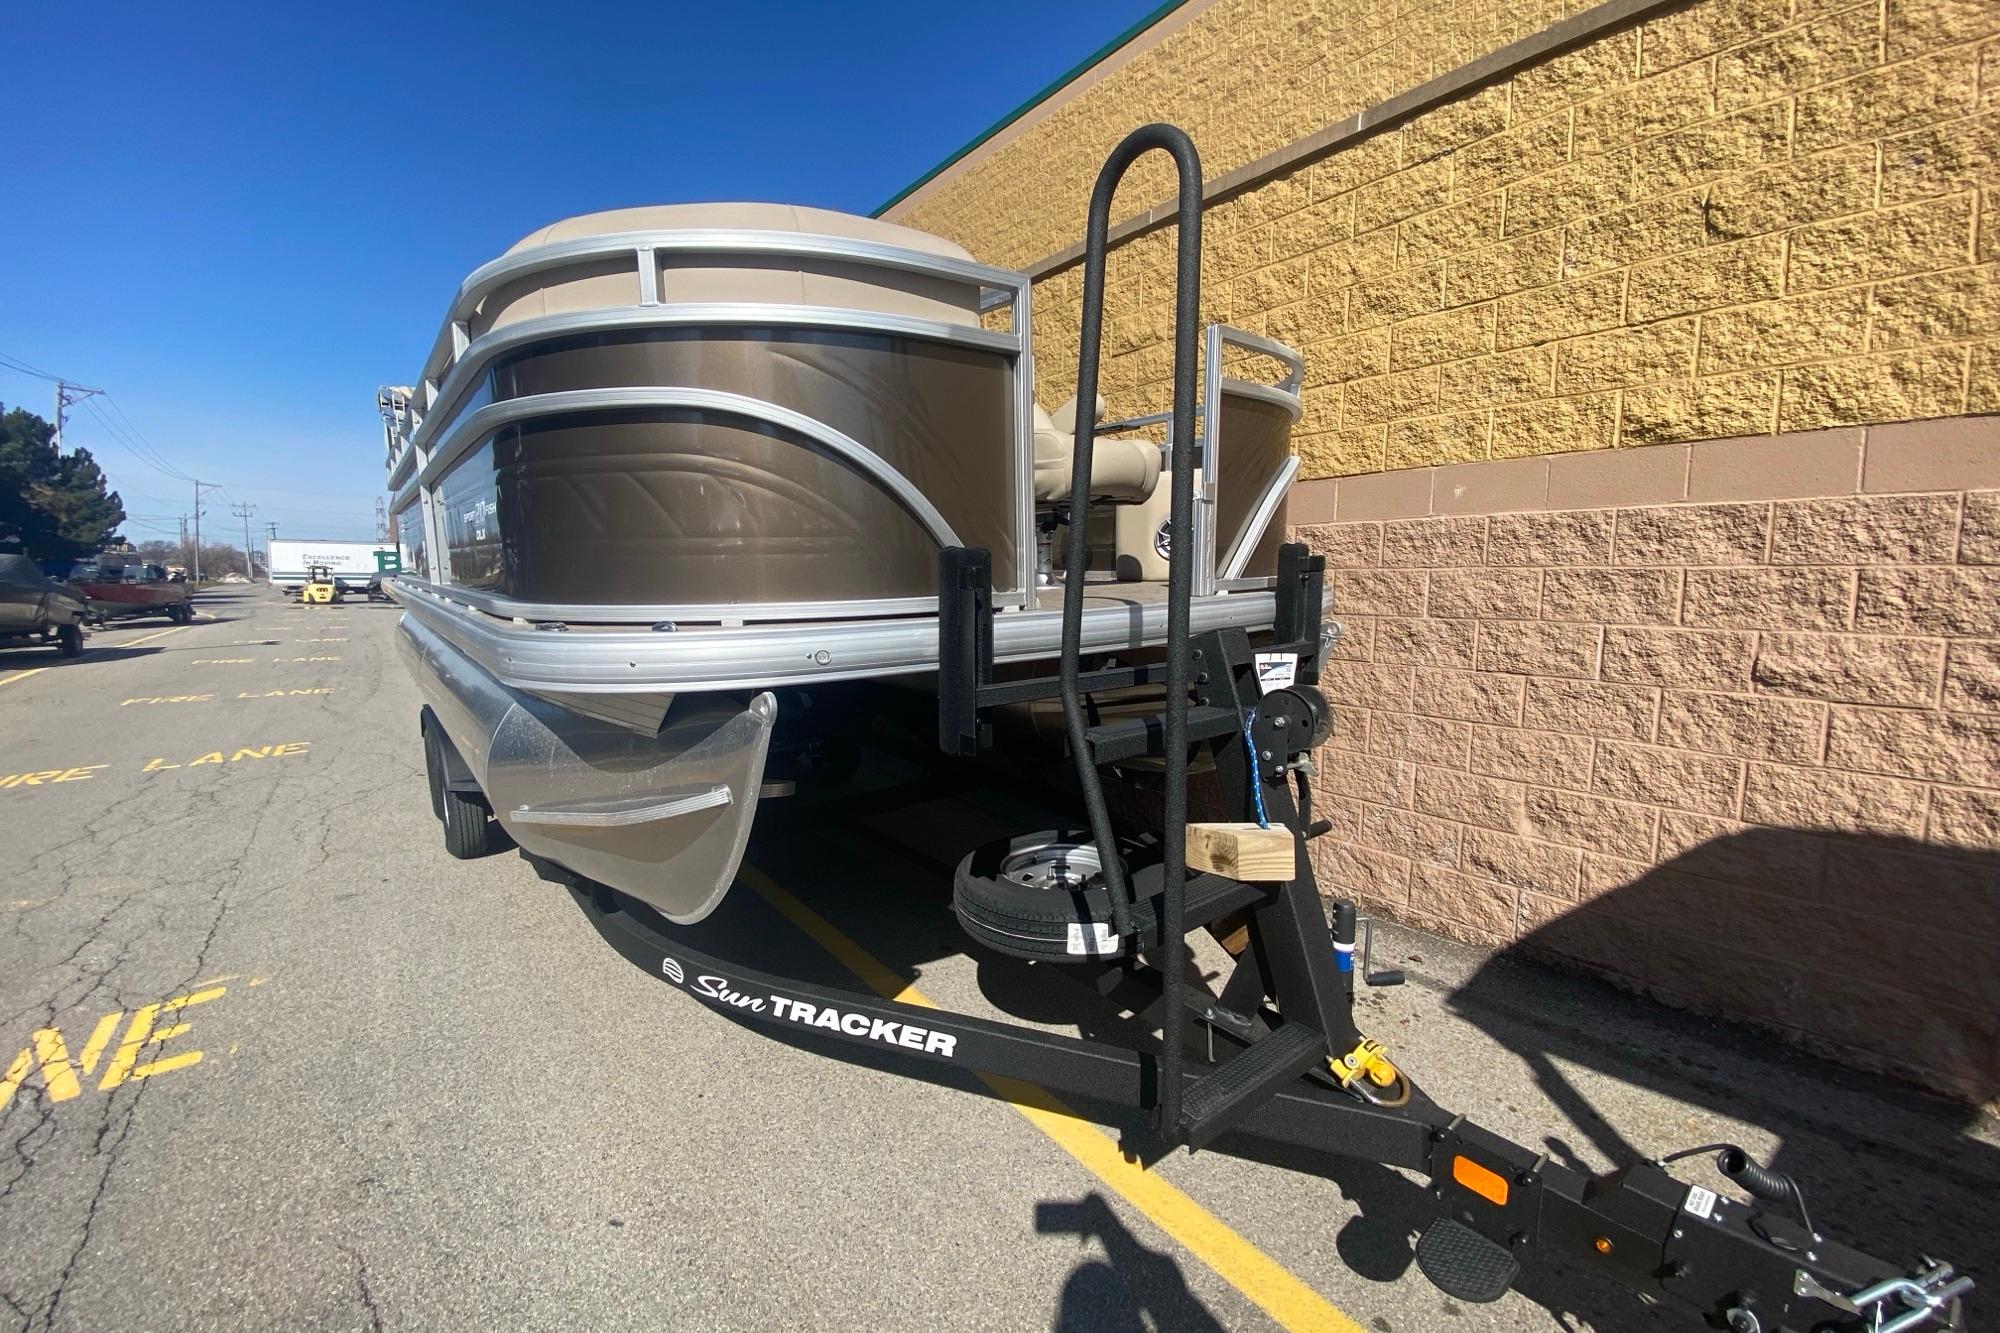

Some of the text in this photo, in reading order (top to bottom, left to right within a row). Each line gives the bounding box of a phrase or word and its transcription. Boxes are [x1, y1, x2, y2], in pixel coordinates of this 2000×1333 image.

[476, 528, 486, 541] DLX
[120, 687, 336, 706] FIRE LANE
[0, 741, 312, 788] IRE LANE
[690, 974, 957, 1058] Sun TRACKER
